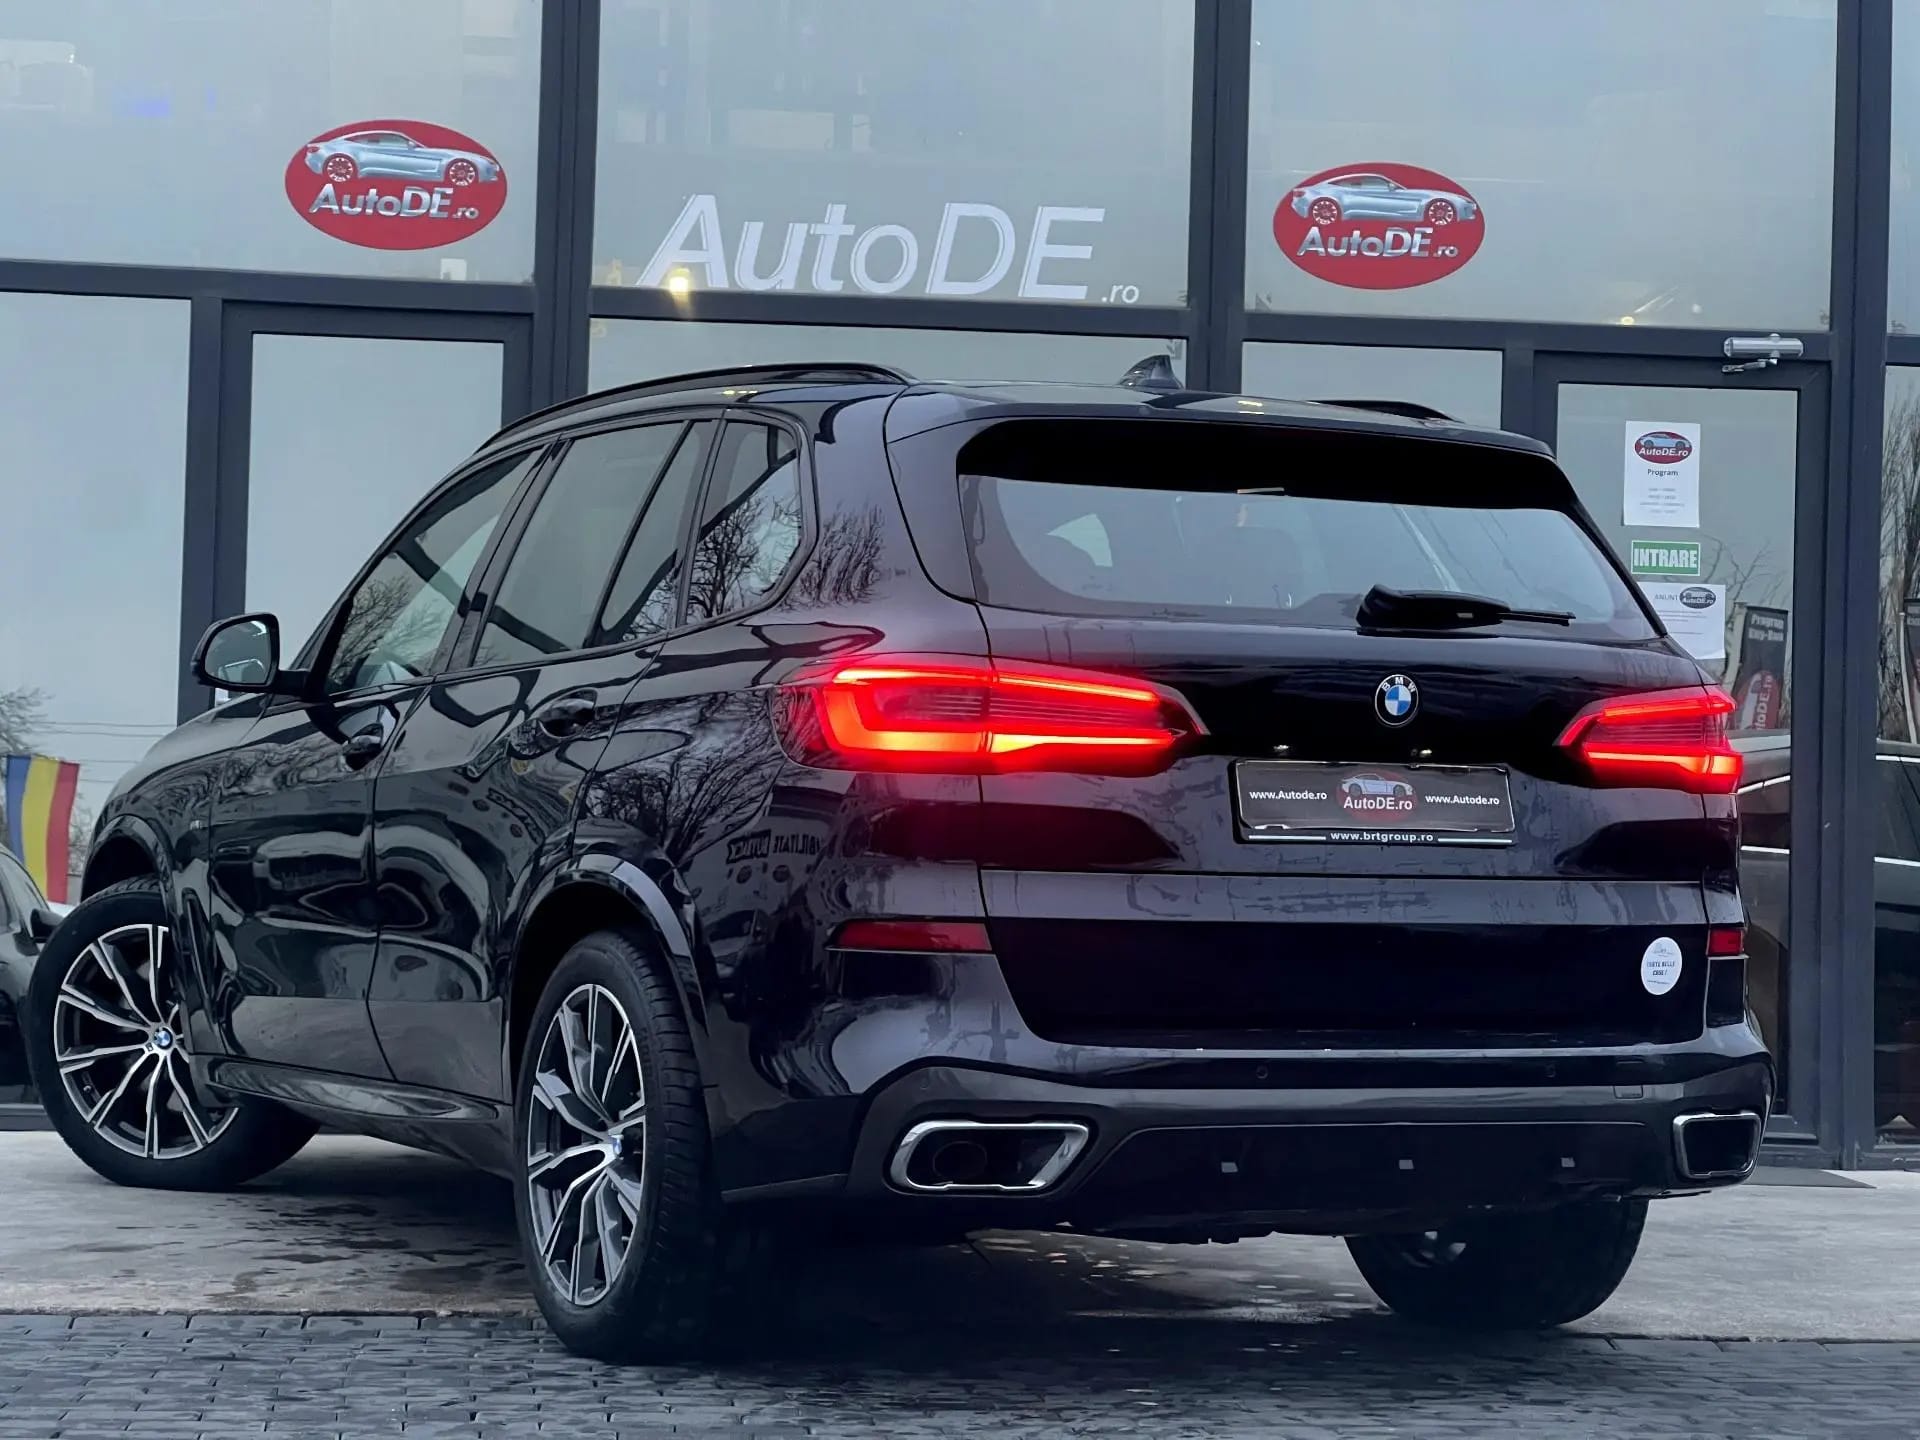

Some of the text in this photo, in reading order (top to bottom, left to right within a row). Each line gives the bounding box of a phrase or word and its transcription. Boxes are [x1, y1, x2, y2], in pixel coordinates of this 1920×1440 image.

[1638, 447, 1689, 458] AutoDE.ro
[1647, 468, 1679, 477] Program
[1633, 547, 1698, 568] INTRARE
[1249, 789, 1328, 801] www.Autode.ro
[1424, 794, 1500, 806] www.Autode.ro
[1343, 796, 1413, 811] AutoDE.ro
[1330, 831, 1434, 843] www.brtgroup.ro
